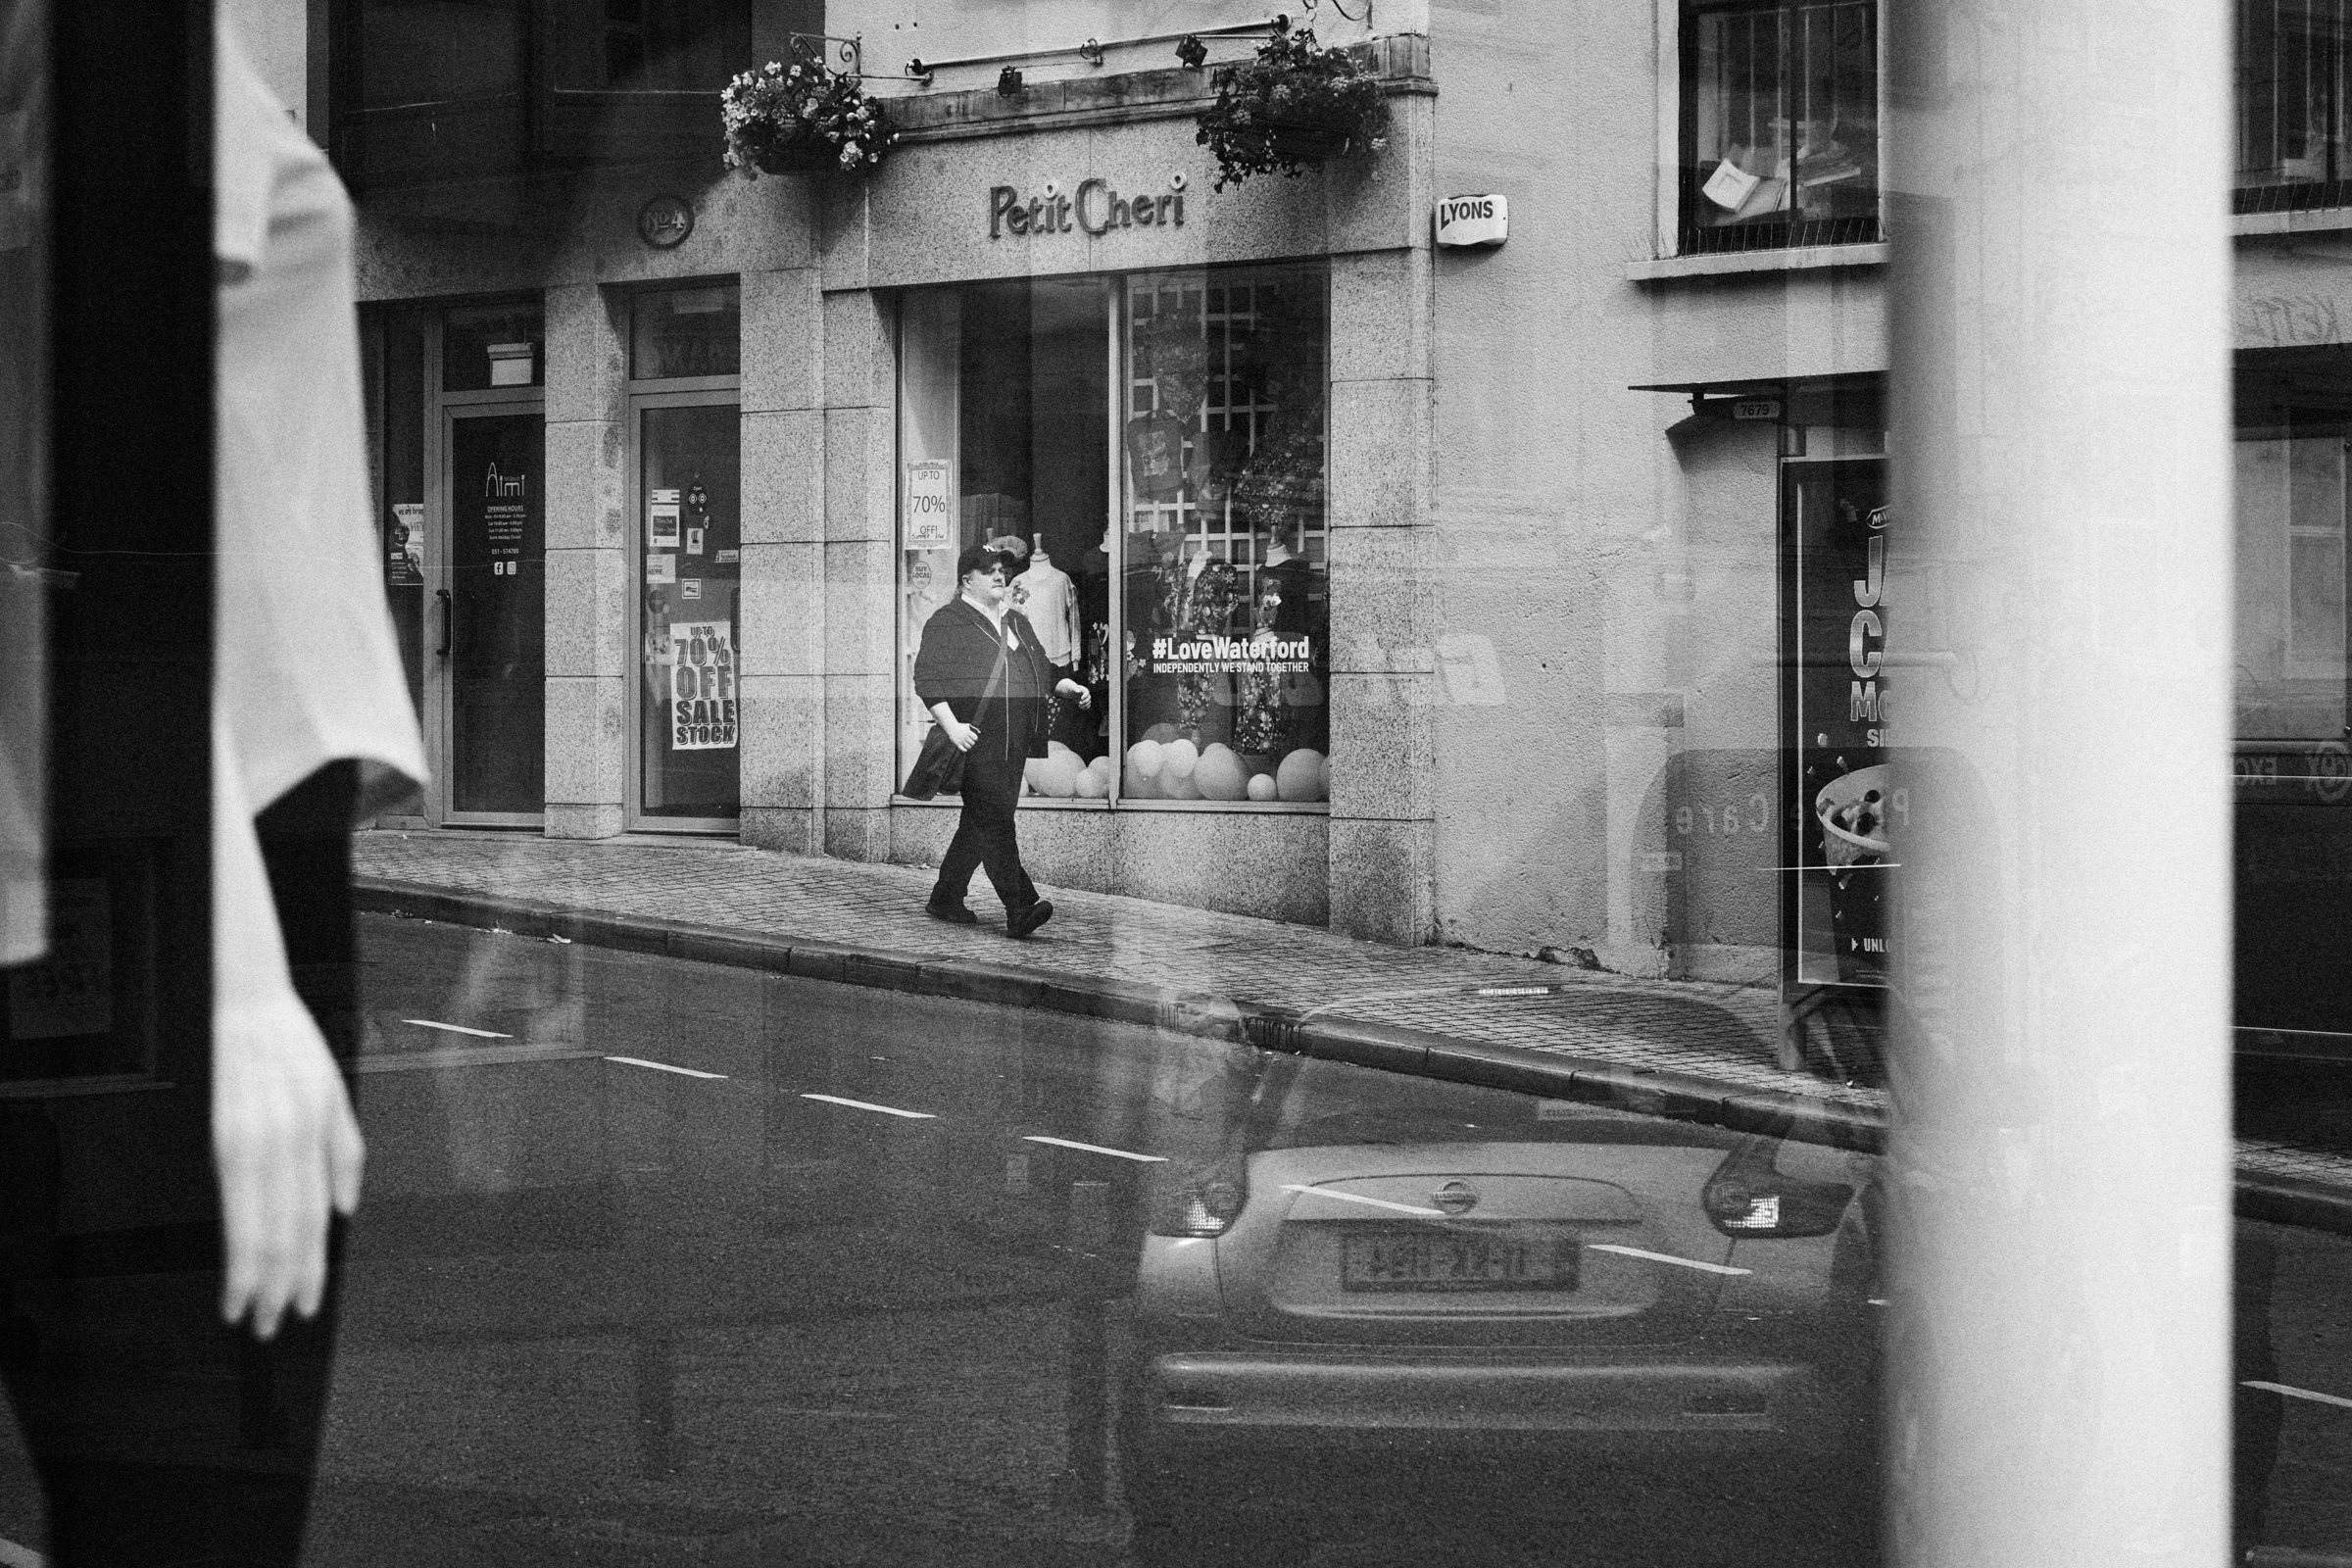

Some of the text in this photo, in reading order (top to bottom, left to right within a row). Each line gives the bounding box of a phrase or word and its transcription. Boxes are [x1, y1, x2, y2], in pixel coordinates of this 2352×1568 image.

[989, 171, 1188, 239] Petit Cheri
[1441, 200, 1494, 230] LYONS
[1740, 403, 1770, 416] 7679
[917, 470, 940, 480] UP TO
[912, 495, 946, 514] 70%
[919, 525, 938, 535] OFF!
[1854, 535, 1889, 607] J
[690, 625, 715, 638] UP TO
[674, 636, 732, 666] 70%
[1152, 636, 1309, 660] #LoveWaterford
[1849, 610, 1888, 678] C
[1152, 662, 1309, 673] INDEPENDENTLY WE STAND TOGETHER
[676, 665, 732, 700] OFF
[676, 699, 735, 726] SALE
[676, 725, 735, 745] STOCK
